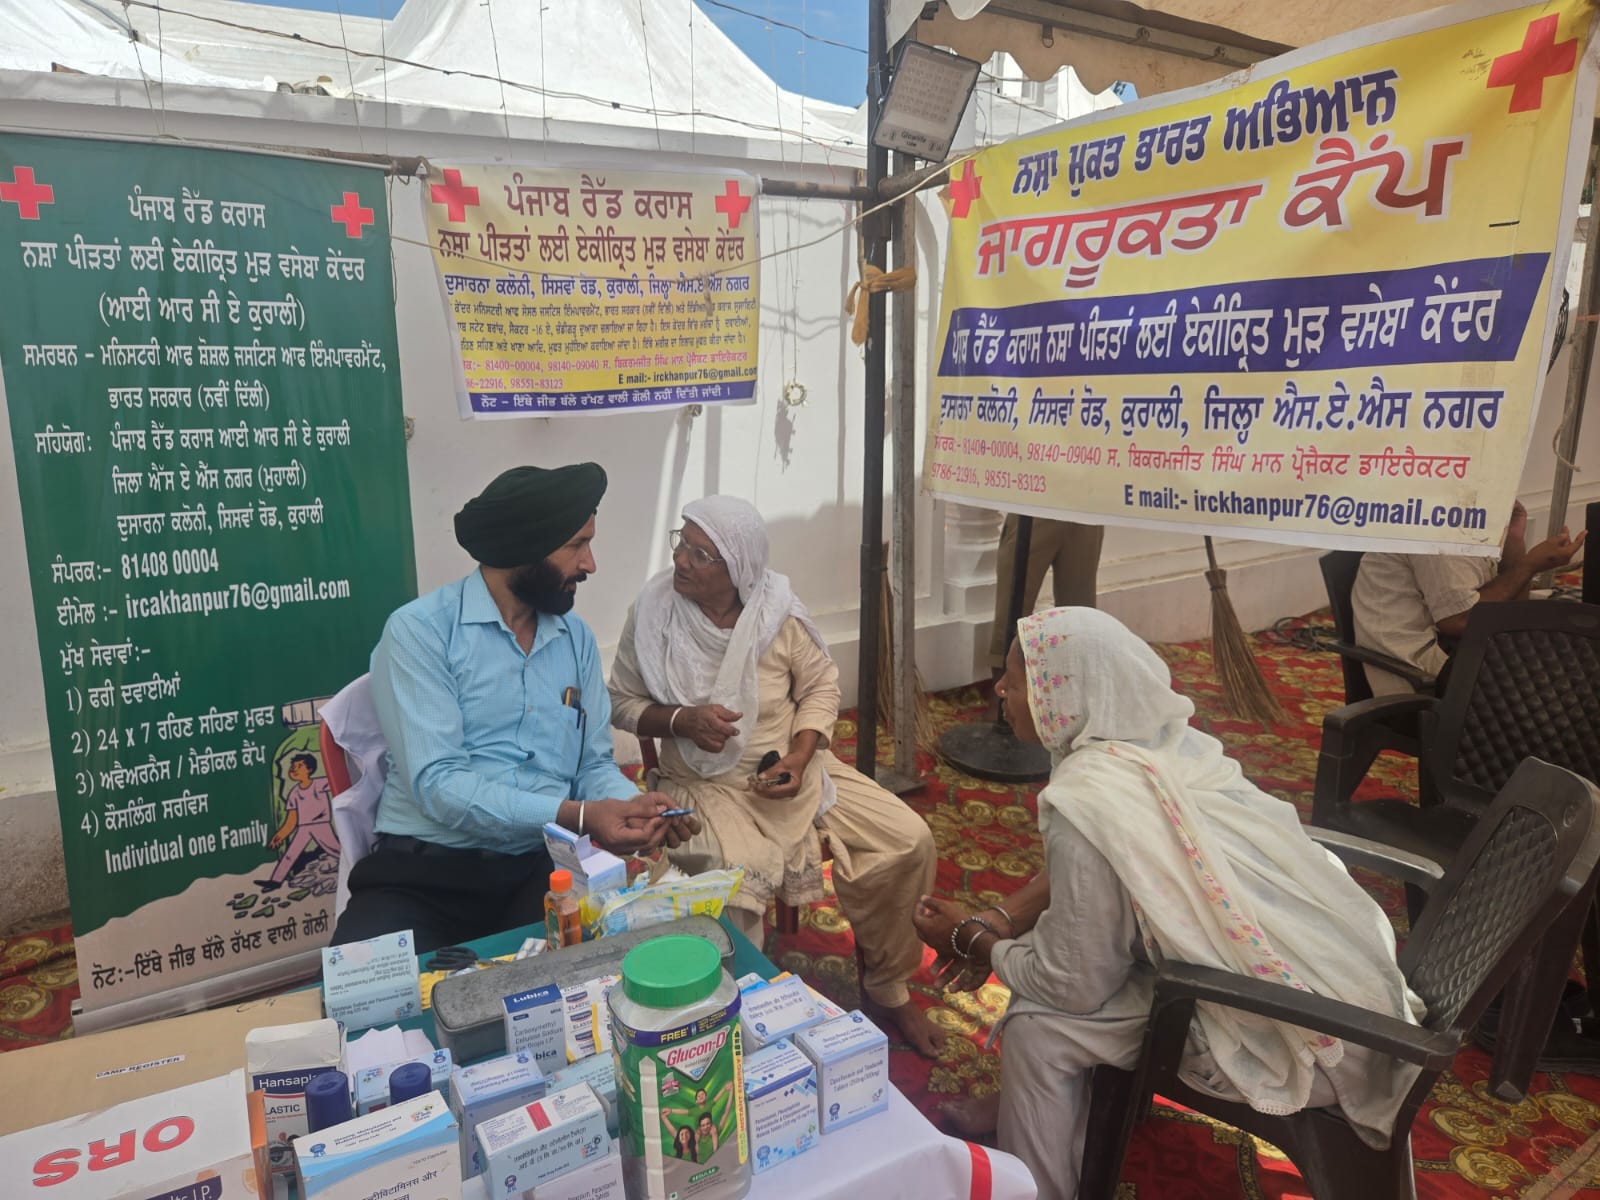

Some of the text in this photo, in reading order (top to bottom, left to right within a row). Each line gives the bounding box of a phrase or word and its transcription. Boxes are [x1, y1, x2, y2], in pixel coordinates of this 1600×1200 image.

[1069, 136, 1125, 197] ਮੁਕਤ
[1135, 116, 1210, 171] ਭਾਰਤ
[1223, 70, 1398, 151] ਅਭਿਆਨ
[128, 185, 265, 228] ਪੰਜਾਬ ਰੈੱਡ ਕਰਾਸ
[504, 172, 692, 219] ਪੰਜਾਬ ਰੈੱਡ ਕਰਾਸ
[976, 134, 1463, 288] ਜਾਗਰੂਕਤਾ ਕੈਂਪ
[67, 234, 121, 270] ਪੀੜਤਾਂ
[130, 236, 164, 271] ਲਈ
[246, 251, 271, 282] ਮੁੜ
[279, 245, 319, 279] ਵਸੇਬਾ
[327, 248, 364, 281] ਕੇਂਦਰ
[479, 222, 531, 261] ਪੀੜਤਾਂ
[538, 224, 569, 262] ਲਈ
[643, 235, 665, 268] ਮੁੜ
[673, 227, 709, 262] ਵਸੇਬਾ
[716, 228, 744, 261] ਕੇਂਦਰ
[445, 272, 749, 298] ਦੁਸਾਰਨਾ ਕਲੋਨੀ, ਸਿਸਵਾਂ ਕੁਰਾਲੀ, ਨਗਰ
[99, 287, 305, 330] (ਆਈ ਆਰ ਸੀ ਏ ਕੁਰਾਲੀ)
[973, 313, 1004, 364] ਰੈੱਡ
[1006, 326, 1042, 365] ਕਰਾਸ
[1080, 305, 1133, 361] ਪੀੜਤਾਂ
[1136, 298, 1178, 359] ਲਈ
[1283, 306, 1329, 367] ਮੁੜ
[1340, 283, 1414, 352] ਵਸੇਬਾ
[1420, 275, 1502, 344] ਕੇਂਦਰ
[23, 344, 77, 367] ਸਮਰਥਨ
[101, 337, 160, 367] ਮਨਿਸਟਰੀ
[166, 344, 192, 367] ਆਫ
[235, 339, 276, 367] ਜਸਟਿਸ
[282, 346, 305, 368] ਆਫ
[108, 387, 143, 409] ਭਾਰਤ
[149, 387, 191, 408] ਸਰਕਾਰ
[198, 380, 228, 411] (ਨਵੀਂ
[481, 395, 497, 407] ਨੋਟ
[608, 390, 628, 403] ਵਾਲੀ
[632, 390, 650, 403] ਗੋਲੀ
[619, 374, 623, 384] E
[977, 385, 1018, 430] ਕਲੋਨੀ,
[1029, 387, 1074, 426] ਸਿਸਵਾਂ
[1080, 385, 1110, 434] ਰੋਡ,
[1120, 383, 1189, 437] ਕੁਰਾਲੀ,
[1424, 391, 1504, 429] ਨਗਰ
[111, 422, 145, 452] ਪੰਜਾਬ
[152, 421, 173, 450] ਰੈੱਡ
[180, 428, 214, 450] ਕਰਾਸ
[219, 420, 248, 449] ਆਈ
[254, 427, 278, 447] ਆਰ
[284, 421, 297, 447] ਸੀ
[302, 420, 311, 446] ਏ
[316, 420, 350, 452] ਕੁਰਾਲੀ
[180, 463, 190, 490] ਏ
[224, 468, 252, 489] ਨਗਰ
[259, 459, 307, 492] (ਮੁਹਾਲੀ)
[984, 470, 1046, 492] 98551-83123
[1027, 442, 1101, 465] 98140-09040
[1128, 443, 1204, 472] ਬਿਕਰਮਜੀਤ
[1212, 445, 1246, 473] ਸਿੰਘ
[1251, 451, 1284, 474] ਮਾਨ
[1358, 445, 1471, 479] ਡਾਇਰੈਕਟਰ
[117, 497, 324, 541] ਦੁਸਾਰਨਾ ਕਲੋਨੀ, ਸਿਸਵਾਂ ਰੋਡ, ਕੁਰਾਲੀ
[1124, 485, 1487, 530] E mail:- irckhanpur76@gmail.com
[121, 548, 219, 580] 81408 00004
[57, 577, 350, 627] ਈਮੇਲ ircakhanpur76@gmail.com
[60, 641, 85, 675] ਮੁੱਖ
[66, 671, 181, 712] 1) ਫਰੀ ਦਵਾਈਆਂ
[71, 731, 91, 755] 2)
[97, 728, 119, 752] 24
[141, 722, 150, 744] 7
[157, 711, 193, 740] ਰਹਿਣ
[244, 705, 275, 733] ਮੁਫਤ
[75, 771, 94, 795] 3)
[188, 746, 237, 774] ਮੈਡੀਕਲ
[242, 739, 265, 766] ਕੈਂਪ
[80, 813, 99, 838] 4)
[163, 790, 209, 820] ਸਰਵਿਸ
[105, 819, 269, 873] Individual one Family
[169, 910, 329, 971] ਜੀਭ ਥੱਲੇ ਰੱਖਣ ਵਾਲੀ ਗੋਲੀ
[513, 990, 550, 1003] Lubica
[667, 1031, 727, 1067] Glucon-D
[96, 1069, 126, 1078] CAMP
[259, 1074, 315, 1088] Hansapl
[266, 1104, 300, 1115] ASTIC
[32, 1115, 195, 1187] ORS
